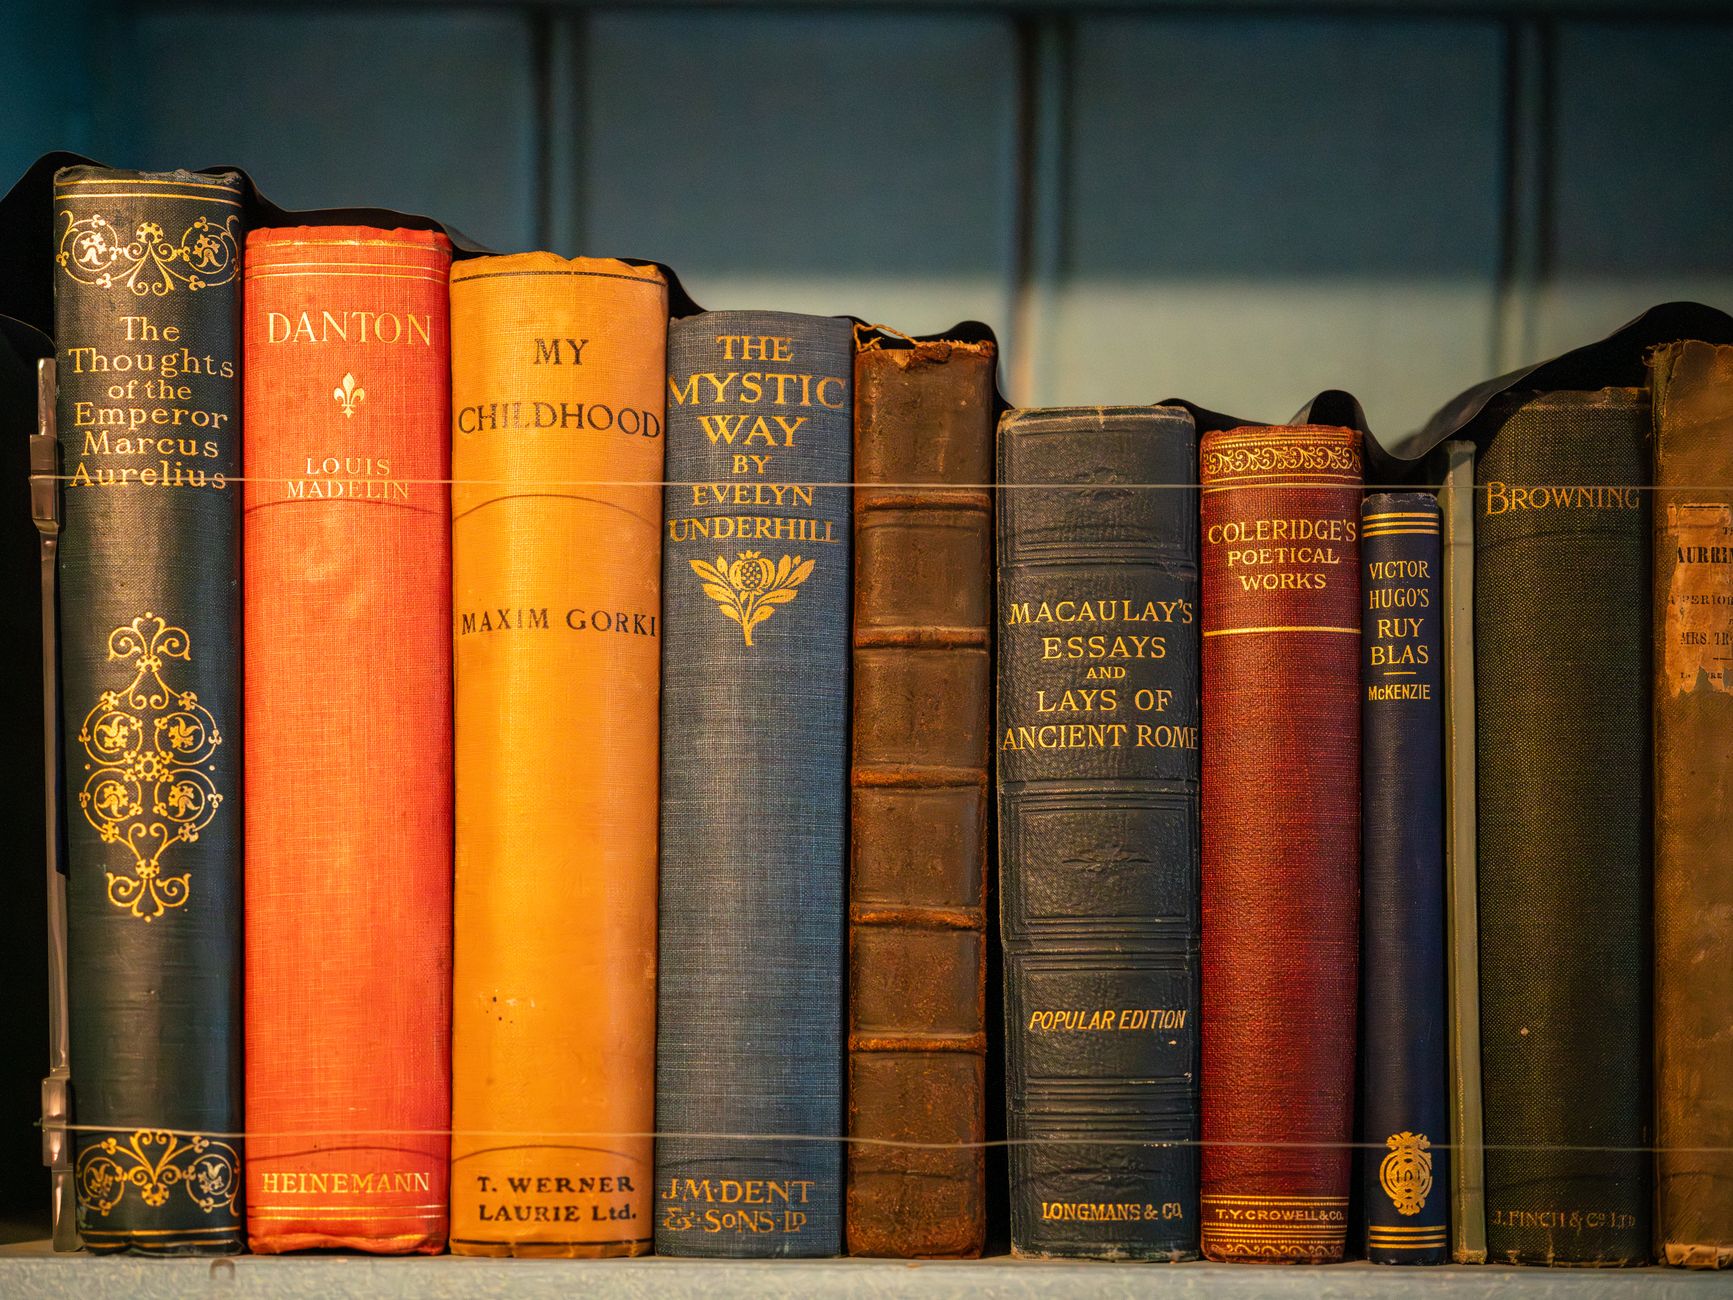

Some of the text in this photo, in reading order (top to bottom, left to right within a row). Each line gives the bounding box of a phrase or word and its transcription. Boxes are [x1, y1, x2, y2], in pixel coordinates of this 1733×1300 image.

[119, 316, 181, 342] The
[267, 311, 432, 347] DANTON
[533, 338, 590, 366] MY
[716, 335, 794, 362] THE
[68, 347, 235, 379] Thoughts
[108, 379, 192, 401] of the
[667, 372, 847, 410] MYSTIC
[74, 402, 229, 431] Emperor
[457, 402, 661, 439] CHILDHOOD
[697, 415, 809, 447] WAY
[81, 431, 220, 459] Marcus
[69, 461, 227, 490] Aurelius
[306, 458, 391, 476] LOUIS
[732, 455, 772, 475] BY
[287, 480, 410, 500] MADELIN
[692, 483, 814, 507] EVELYN
[668, 516, 839, 544] UNDERHILL
[1208, 519, 1357, 544] COLERIDGE'S
[1227, 548, 1340, 567] POETICAL
[1238, 573, 1328, 591] WORKS
[1368, 560, 1431, 582] VICTOR
[1368, 588, 1430, 610] HUGO'S
[461, 607, 657, 638] MAXIM GORKI
[1008, 598, 1193, 626] MACAULAY'S
[1377, 617, 1425, 639] RUY
[1041, 636, 1167, 660] ESSAYS
[1370, 644, 1429, 666] BLAS
[1086, 666, 1127, 680] AND
[1036, 689, 1173, 714] LAYS OF
[1367, 683, 1432, 702] McKENZIE
[1001, 724, 1198, 751] ANCIENT ROME
[1028, 1010, 1188, 1031] POPULAR EDITION
[261, 1172, 431, 1194] HEINEMANN
[477, 1175, 636, 1194] T. WERNER
[478, 1203, 637, 1223] LAURIE Ltd.
[1041, 1202, 1141, 1221] LONGMANS
[1144, 1203, 1159, 1221] &
